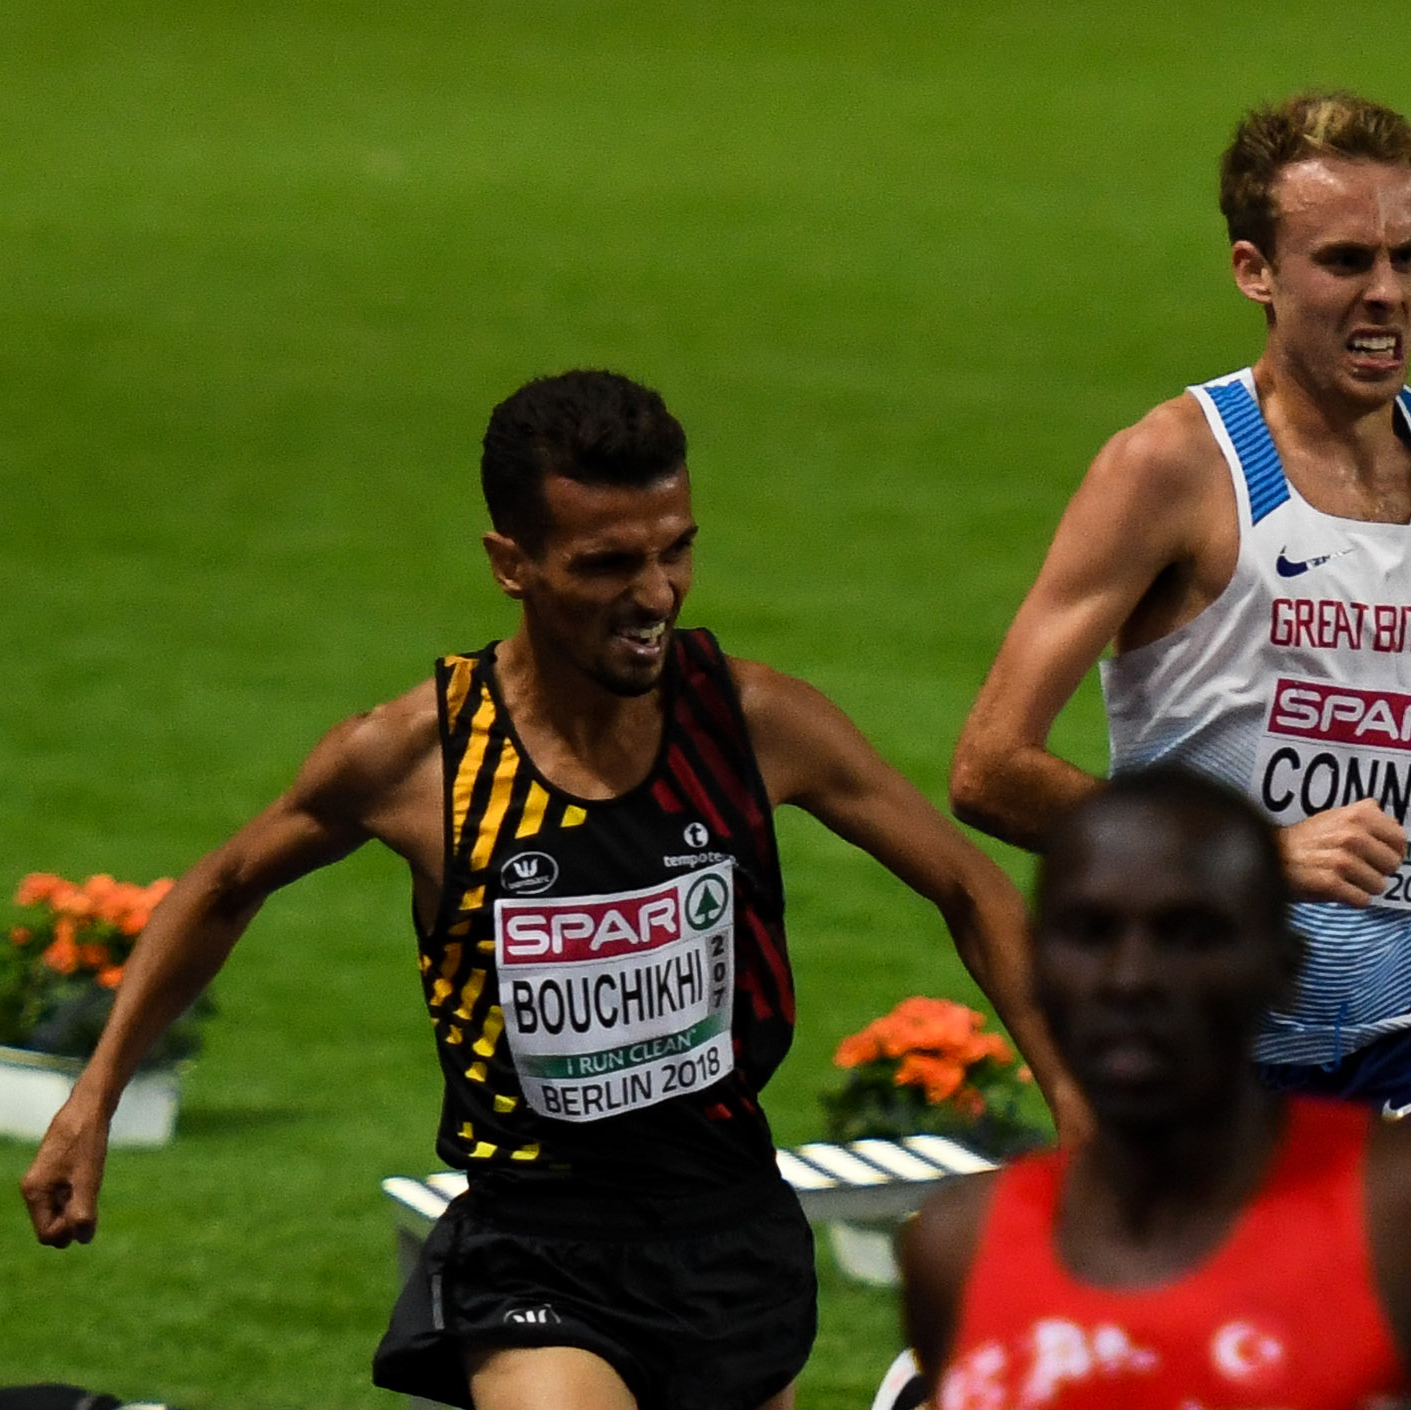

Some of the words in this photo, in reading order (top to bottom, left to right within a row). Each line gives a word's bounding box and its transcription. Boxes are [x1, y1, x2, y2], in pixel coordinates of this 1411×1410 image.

[1270, 599, 1369, 650] GREAT
[507, 898, 677, 955] SPAR
[512, 949, 703, 1035] BOUCHIKHI
[542, 1071, 652, 1116] BERLIN
[662, 1047, 721, 1093] 2018
[567, 1060, 573, 1075] I
[579, 1051, 624, 1073] RUN
[630, 1033, 692, 1062] CLEAN
